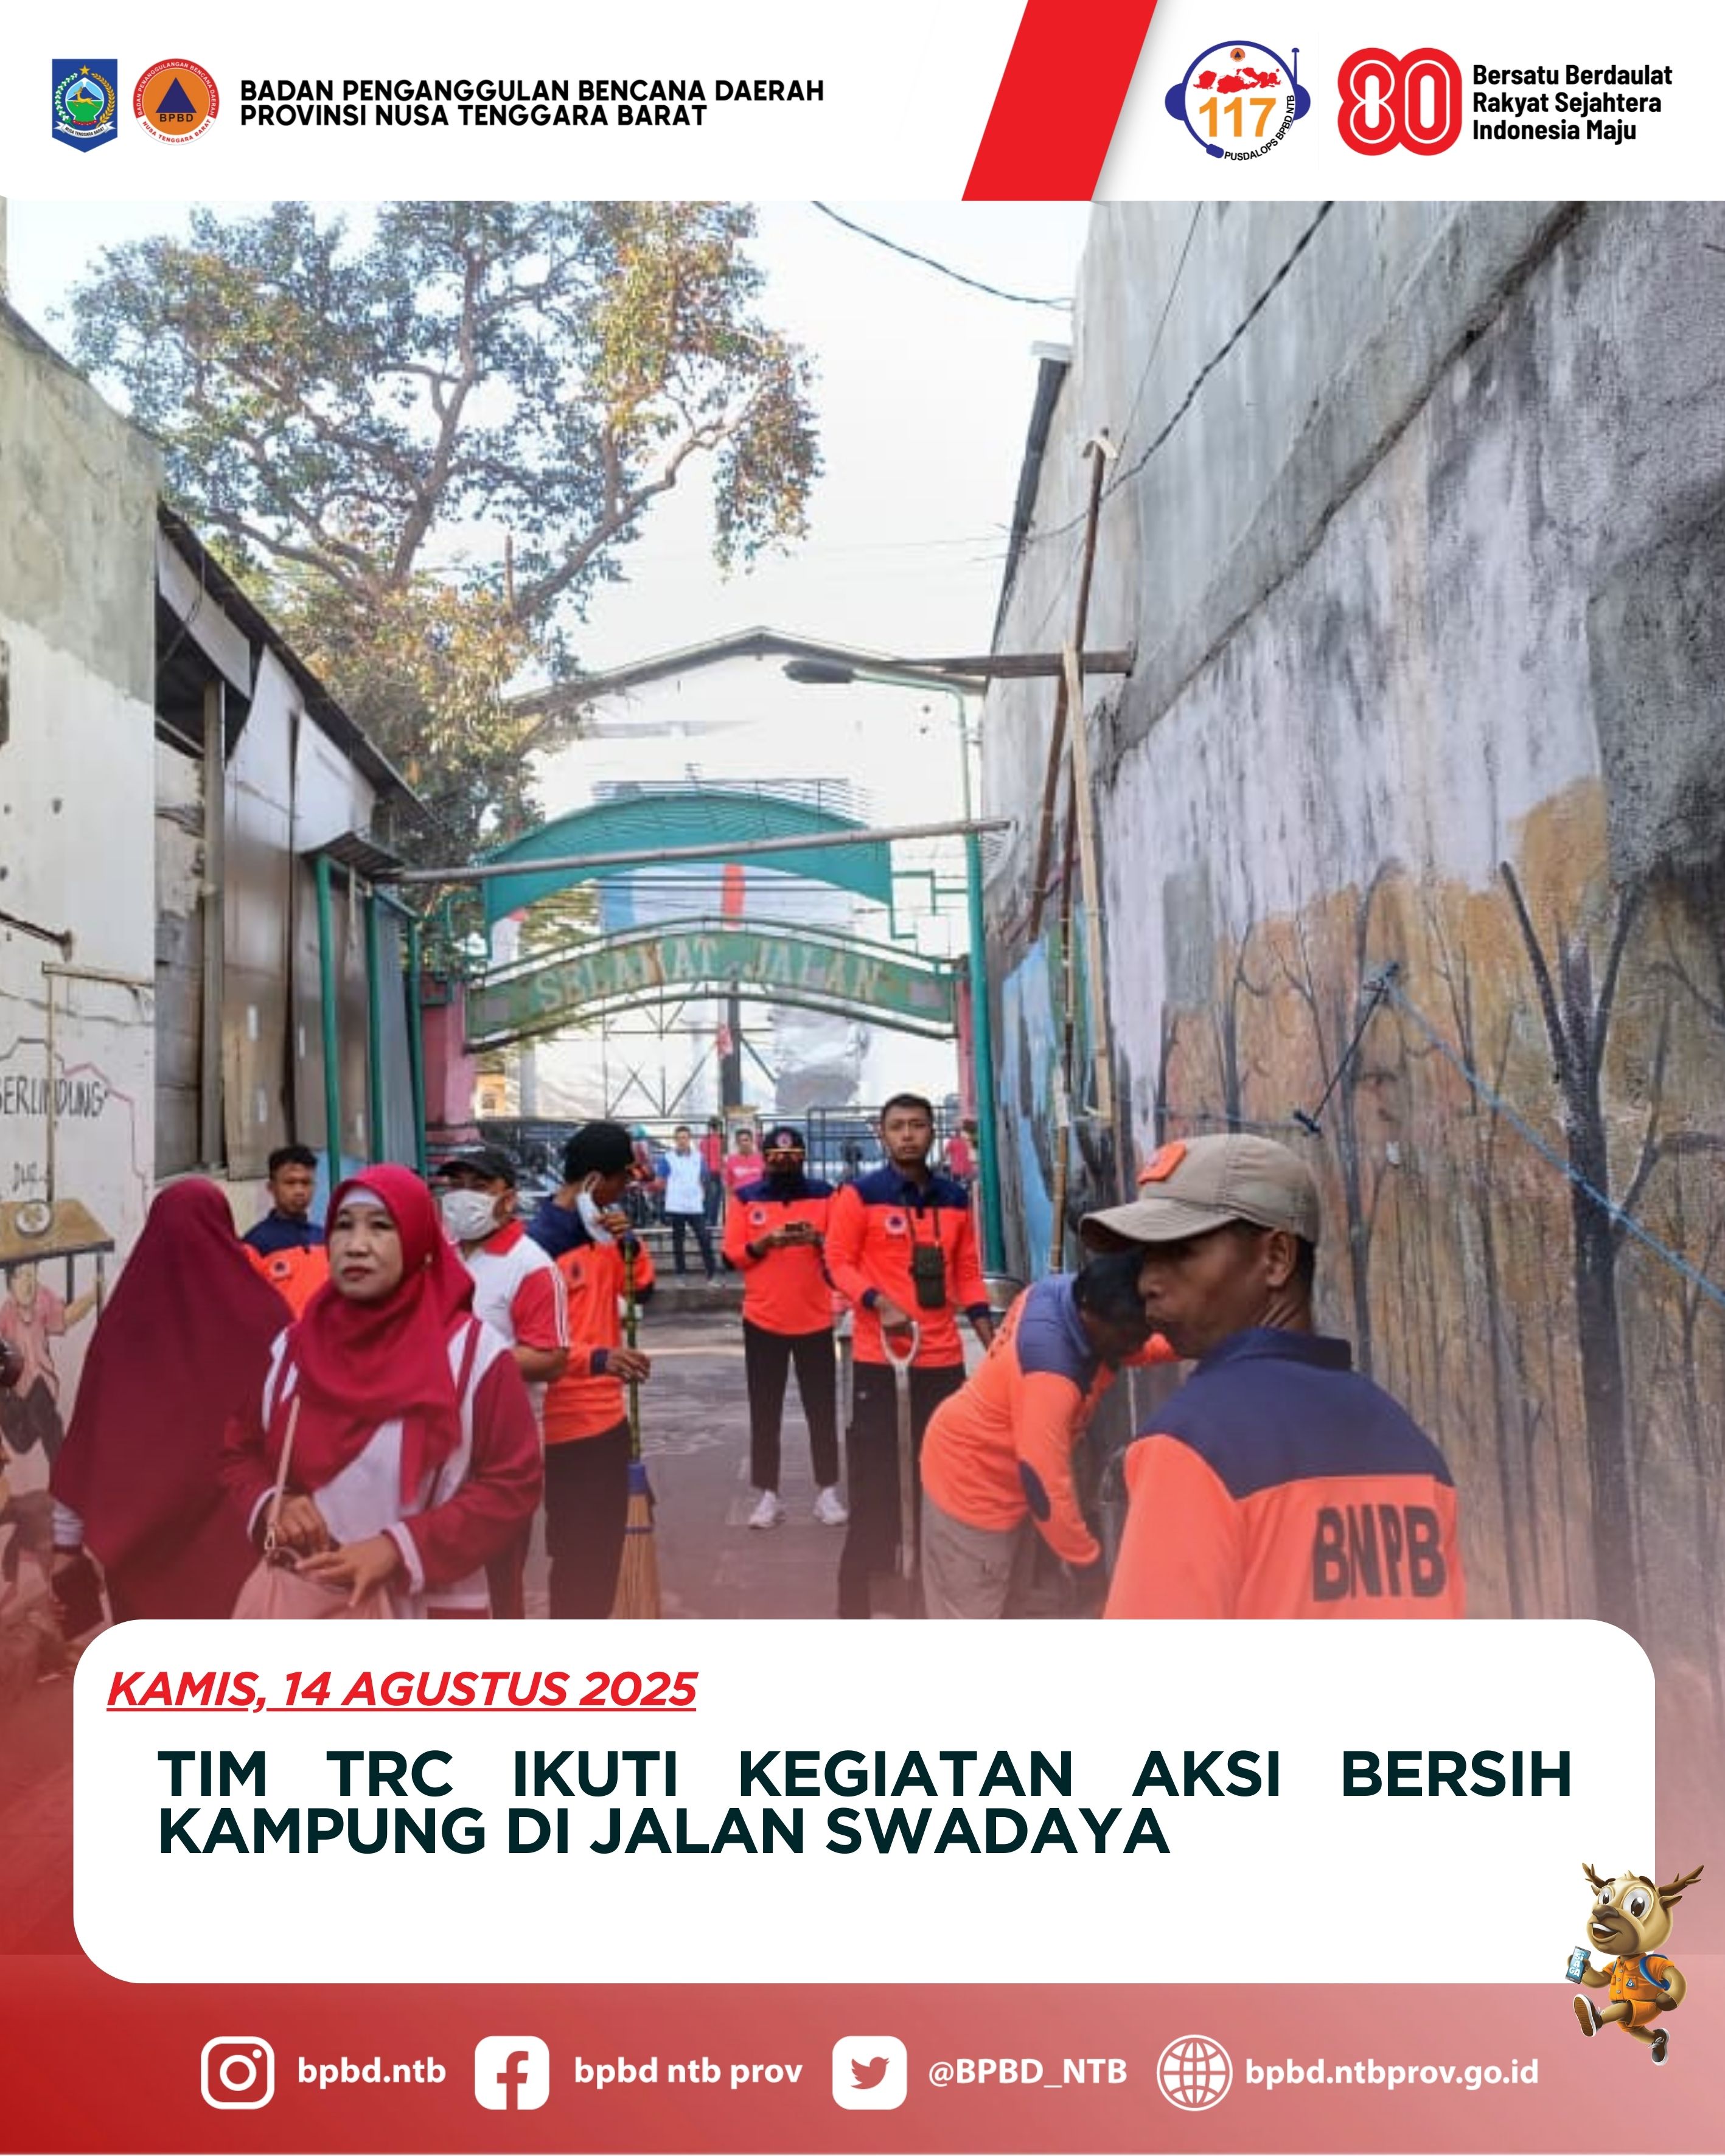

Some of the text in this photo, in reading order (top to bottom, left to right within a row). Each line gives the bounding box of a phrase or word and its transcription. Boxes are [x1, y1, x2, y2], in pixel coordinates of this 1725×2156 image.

[536, 937, 882, 1011] SELAMAT JALAN
[1312, 1503, 1446, 1602] BNPB
